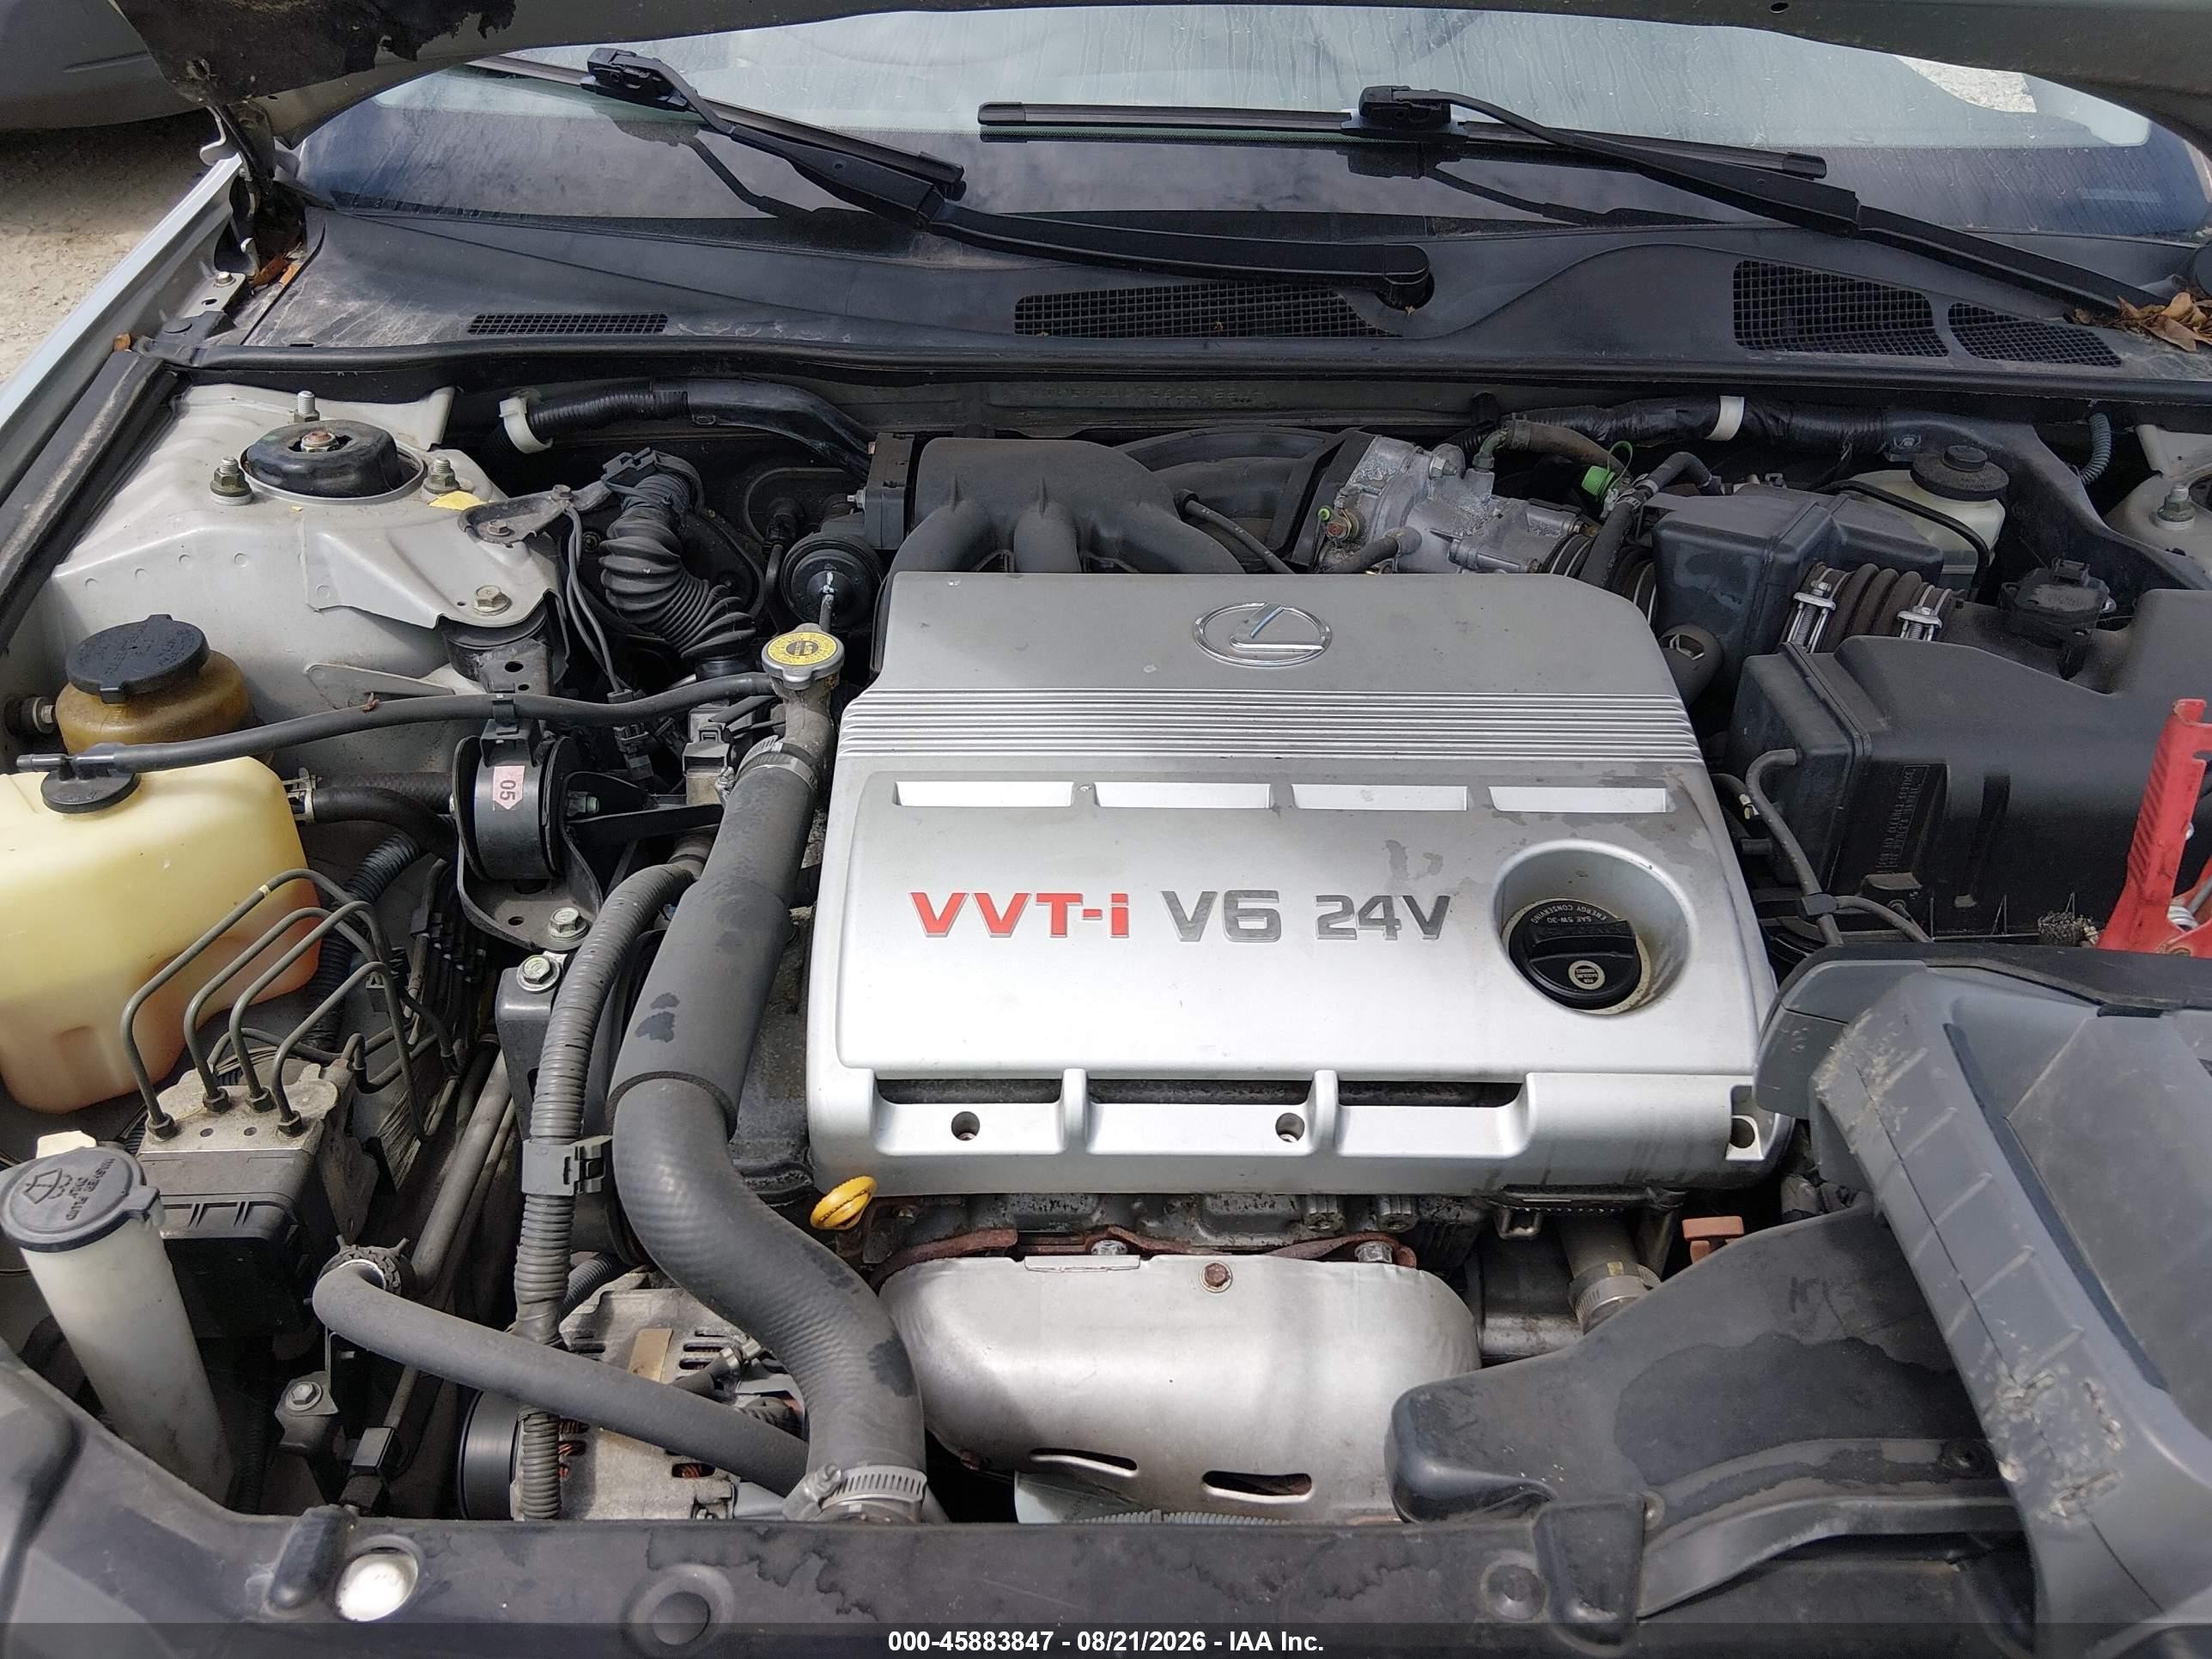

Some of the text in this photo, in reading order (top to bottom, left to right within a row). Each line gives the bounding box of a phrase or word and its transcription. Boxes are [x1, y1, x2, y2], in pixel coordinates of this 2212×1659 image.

[500, 780, 516, 800] 05
[909, 890, 1451, 942] VVT-i V6 24V
[1530, 904, 1608, 924] ENERGY CONSERVING
